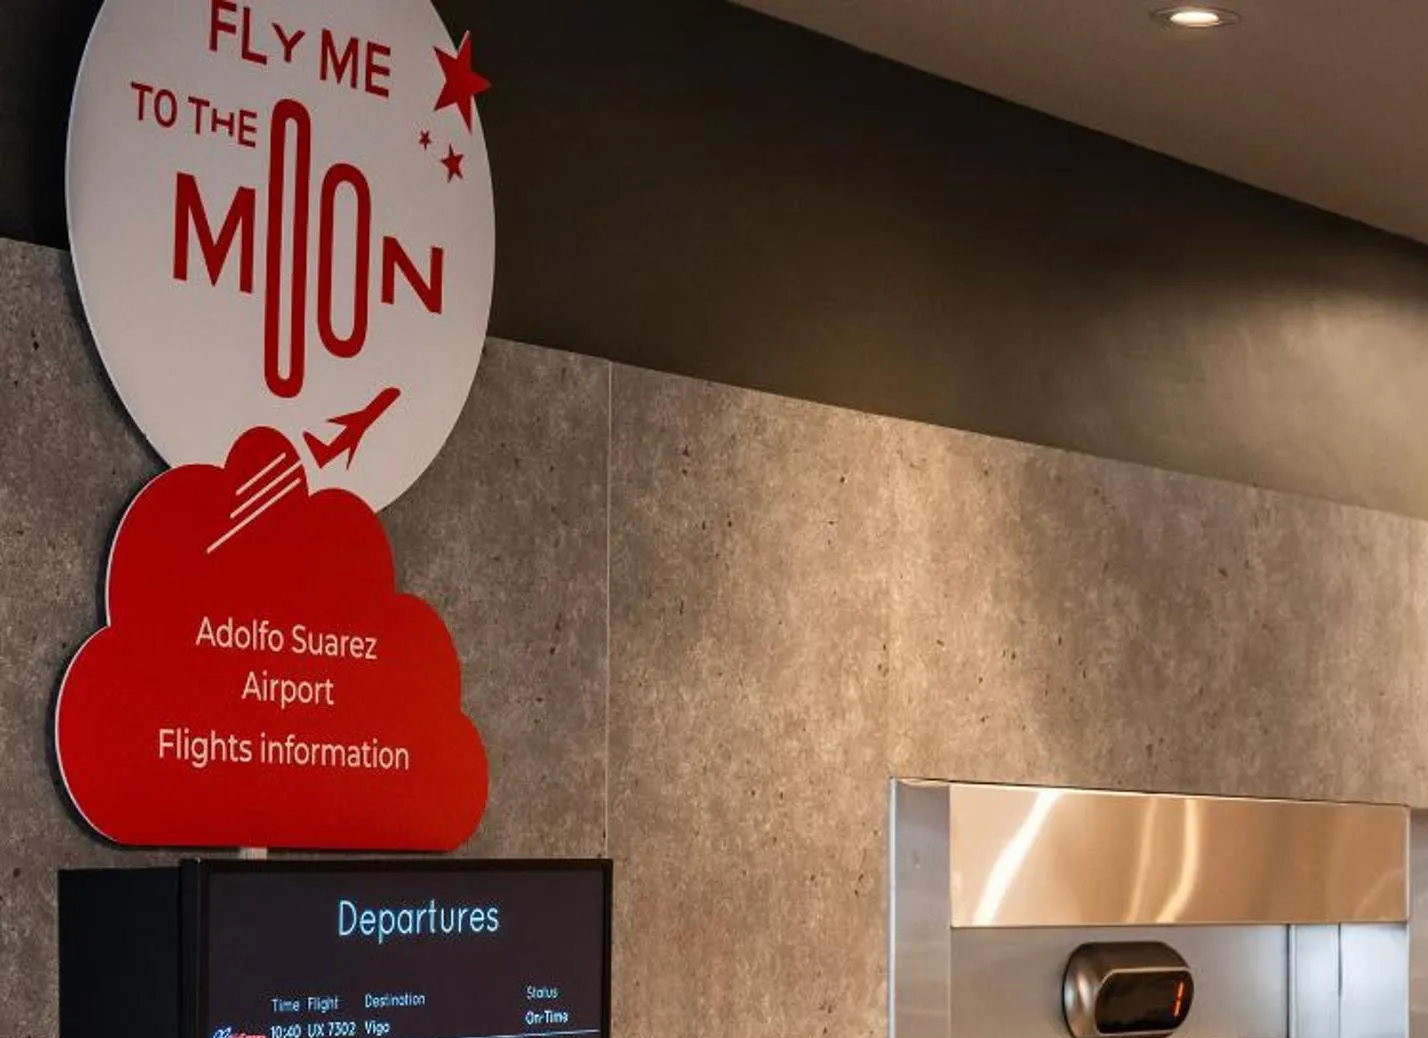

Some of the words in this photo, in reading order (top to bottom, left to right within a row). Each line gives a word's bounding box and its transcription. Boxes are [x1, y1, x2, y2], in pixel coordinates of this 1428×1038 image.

[209, 0, 305, 65] FLY
[319, 28, 391, 98] ME
[130, 81, 178, 128] TO
[187, 96, 258, 148] THE
[173, 99, 444, 398] MOON
[196, 616, 285, 652] Adolfo
[291, 624, 378, 660] Suarez
[241, 671, 334, 709] Airport
[158, 728, 253, 768] Flights
[260, 732, 410, 770] information
[338, 898, 500, 944] Departures
[271, 998, 300, 1012] Time
[308, 996, 338, 1013] Flight
[365, 993, 425, 1008] Destination
[527, 986, 558, 1000] Status
[365, 1020, 390, 1036] Vigo
[525, 1010, 568, 1025] On-Time
